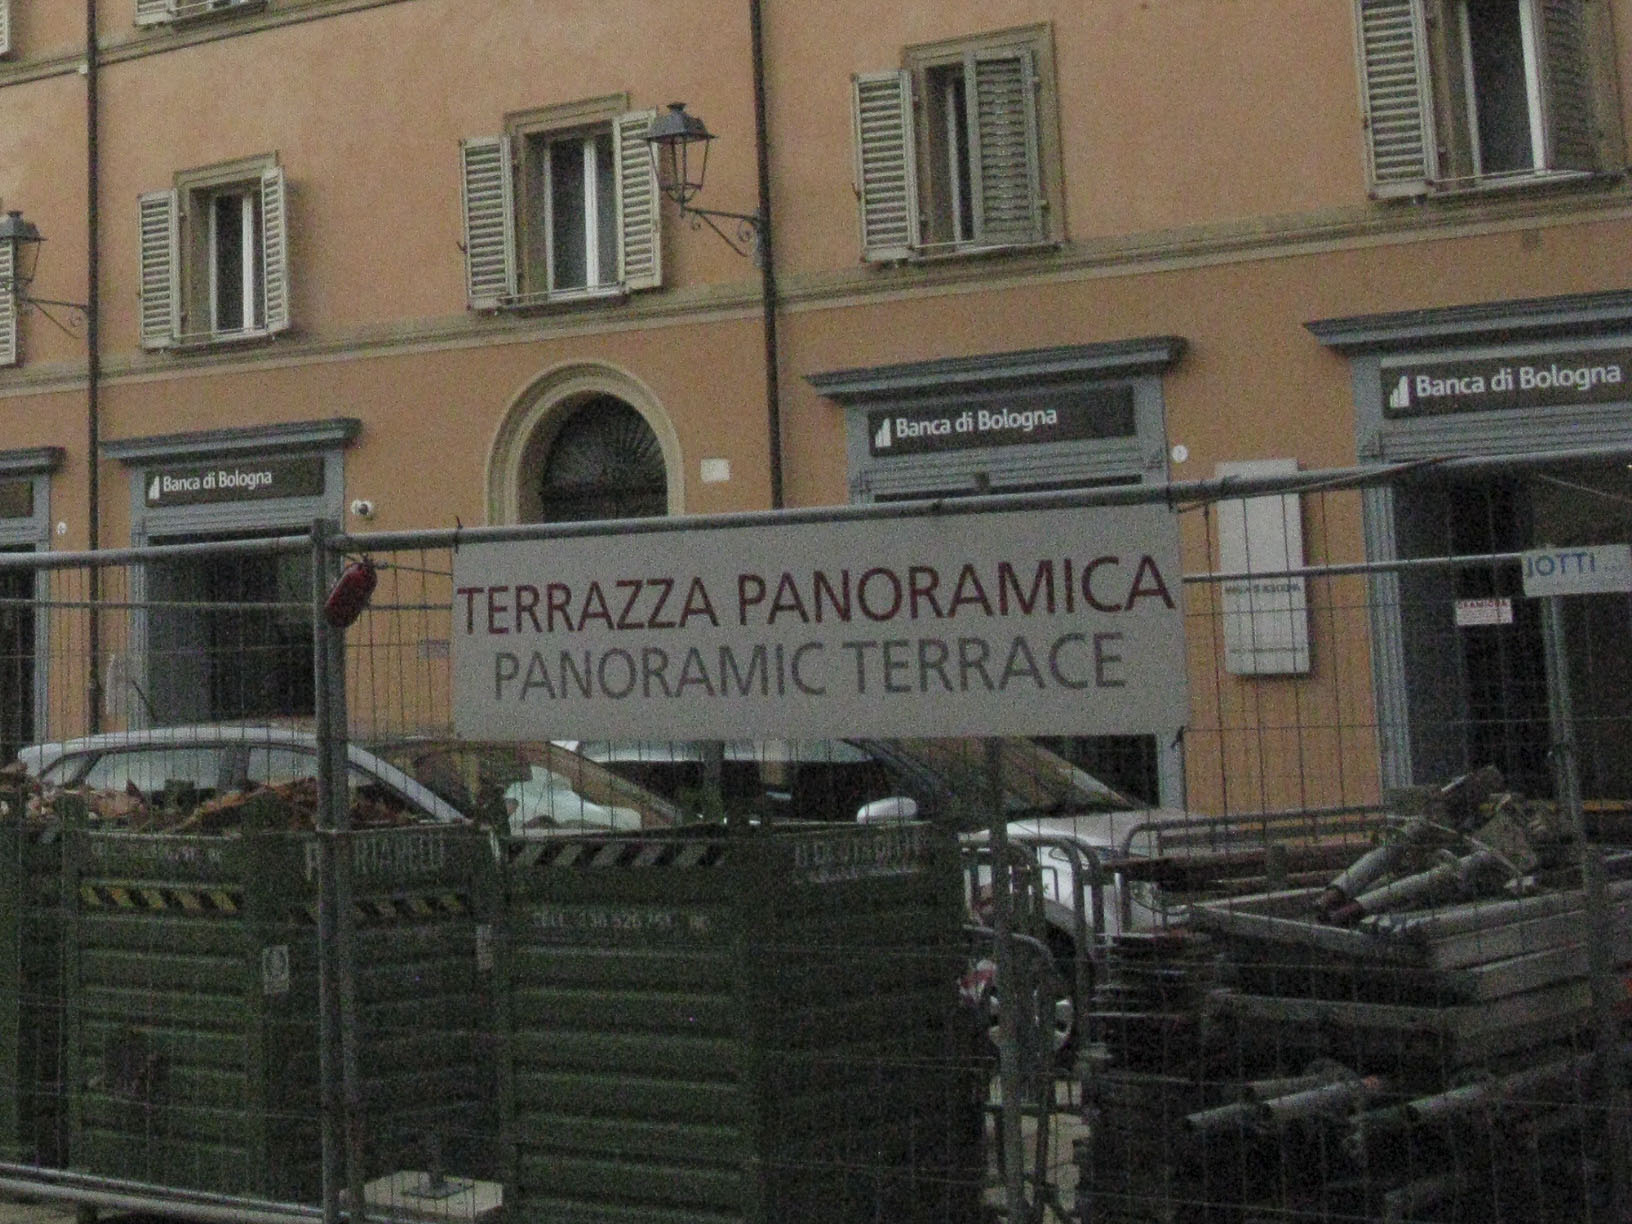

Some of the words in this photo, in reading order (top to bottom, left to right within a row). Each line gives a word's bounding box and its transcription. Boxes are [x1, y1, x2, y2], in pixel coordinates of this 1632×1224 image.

[1416, 374, 1485, 398] Banca
[1491, 367, 1512, 391] di
[1519, 363, 1622, 392] Bologna
[895, 416, 952, 438] Banca
[955, 408, 974, 433] di
[978, 406, 1058, 434] Bologna
[162, 473, 200, 494] Banca
[202, 470, 216, 489] di
[218, 469, 273, 491] Bologna
[456, 575, 720, 636] TERRAZZA
[737, 554, 1176, 627] PANORAMICA
[494, 641, 829, 702] PANORAMIC
[842, 631, 1127, 695] TERRACE
